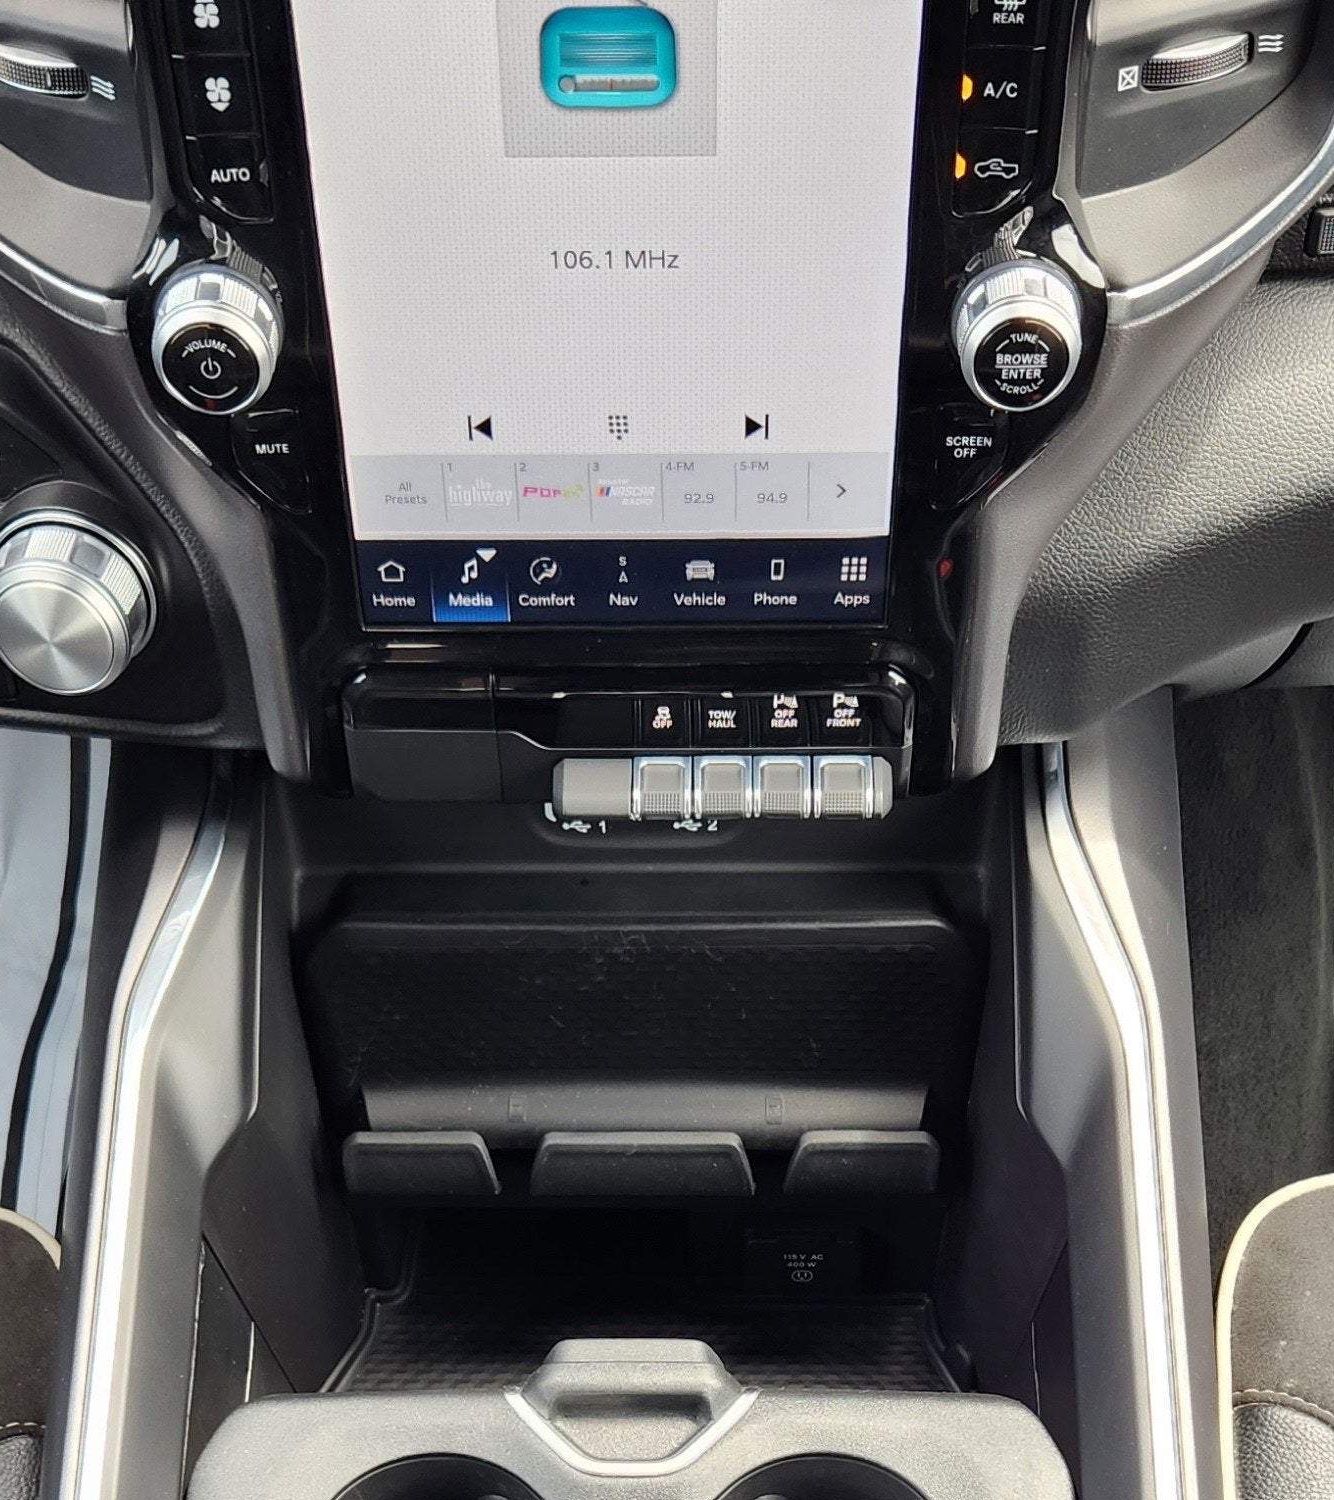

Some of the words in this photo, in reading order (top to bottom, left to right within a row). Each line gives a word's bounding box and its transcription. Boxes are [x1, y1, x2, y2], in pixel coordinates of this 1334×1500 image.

[993, 12, 1025, 24] REAR
[983, 81, 1017, 99] A/C
[211, 168, 251, 183] AUTO
[551, 250, 612, 269] 106.1
[625, 250, 680, 269] MHz
[1010, 333, 1039, 344] TUNE
[185, 339, 229, 353] VOLUME
[996, 354, 1048, 365] BROWSE
[1001, 368, 1041, 380] ENTER
[999, 383, 1040, 394] SCROLL
[945, 436, 993, 448] SCREEN
[255, 443, 289, 455] MUTE
[953, 448, 977, 458] OFF
[665, 462, 695, 471] 4-FM
[740, 461, 769, 471] 5-FM
[399, 482, 412, 492] All
[385, 494, 427, 505] Presets
[449, 484, 512, 506] highway
[684, 494, 715, 504] 92.9
[757, 493, 787, 504] 94.9
[373, 593, 416, 607] Home
[449, 592, 493, 607] Media
[519, 593, 575, 607] Comfort
[609, 593, 639, 606] Nav
[673, 592, 726, 606] Vehicle
[753, 592, 797, 606] Phone
[833, 592, 870, 608] Apps
[774, 710, 795, 719] OFF
[834, 709, 855, 718] OFF
[653, 720, 673, 729] OFF
[708, 720, 736, 729] HAUL
[771, 719, 797, 728] REAR
[827, 718, 861, 728] FRONT
